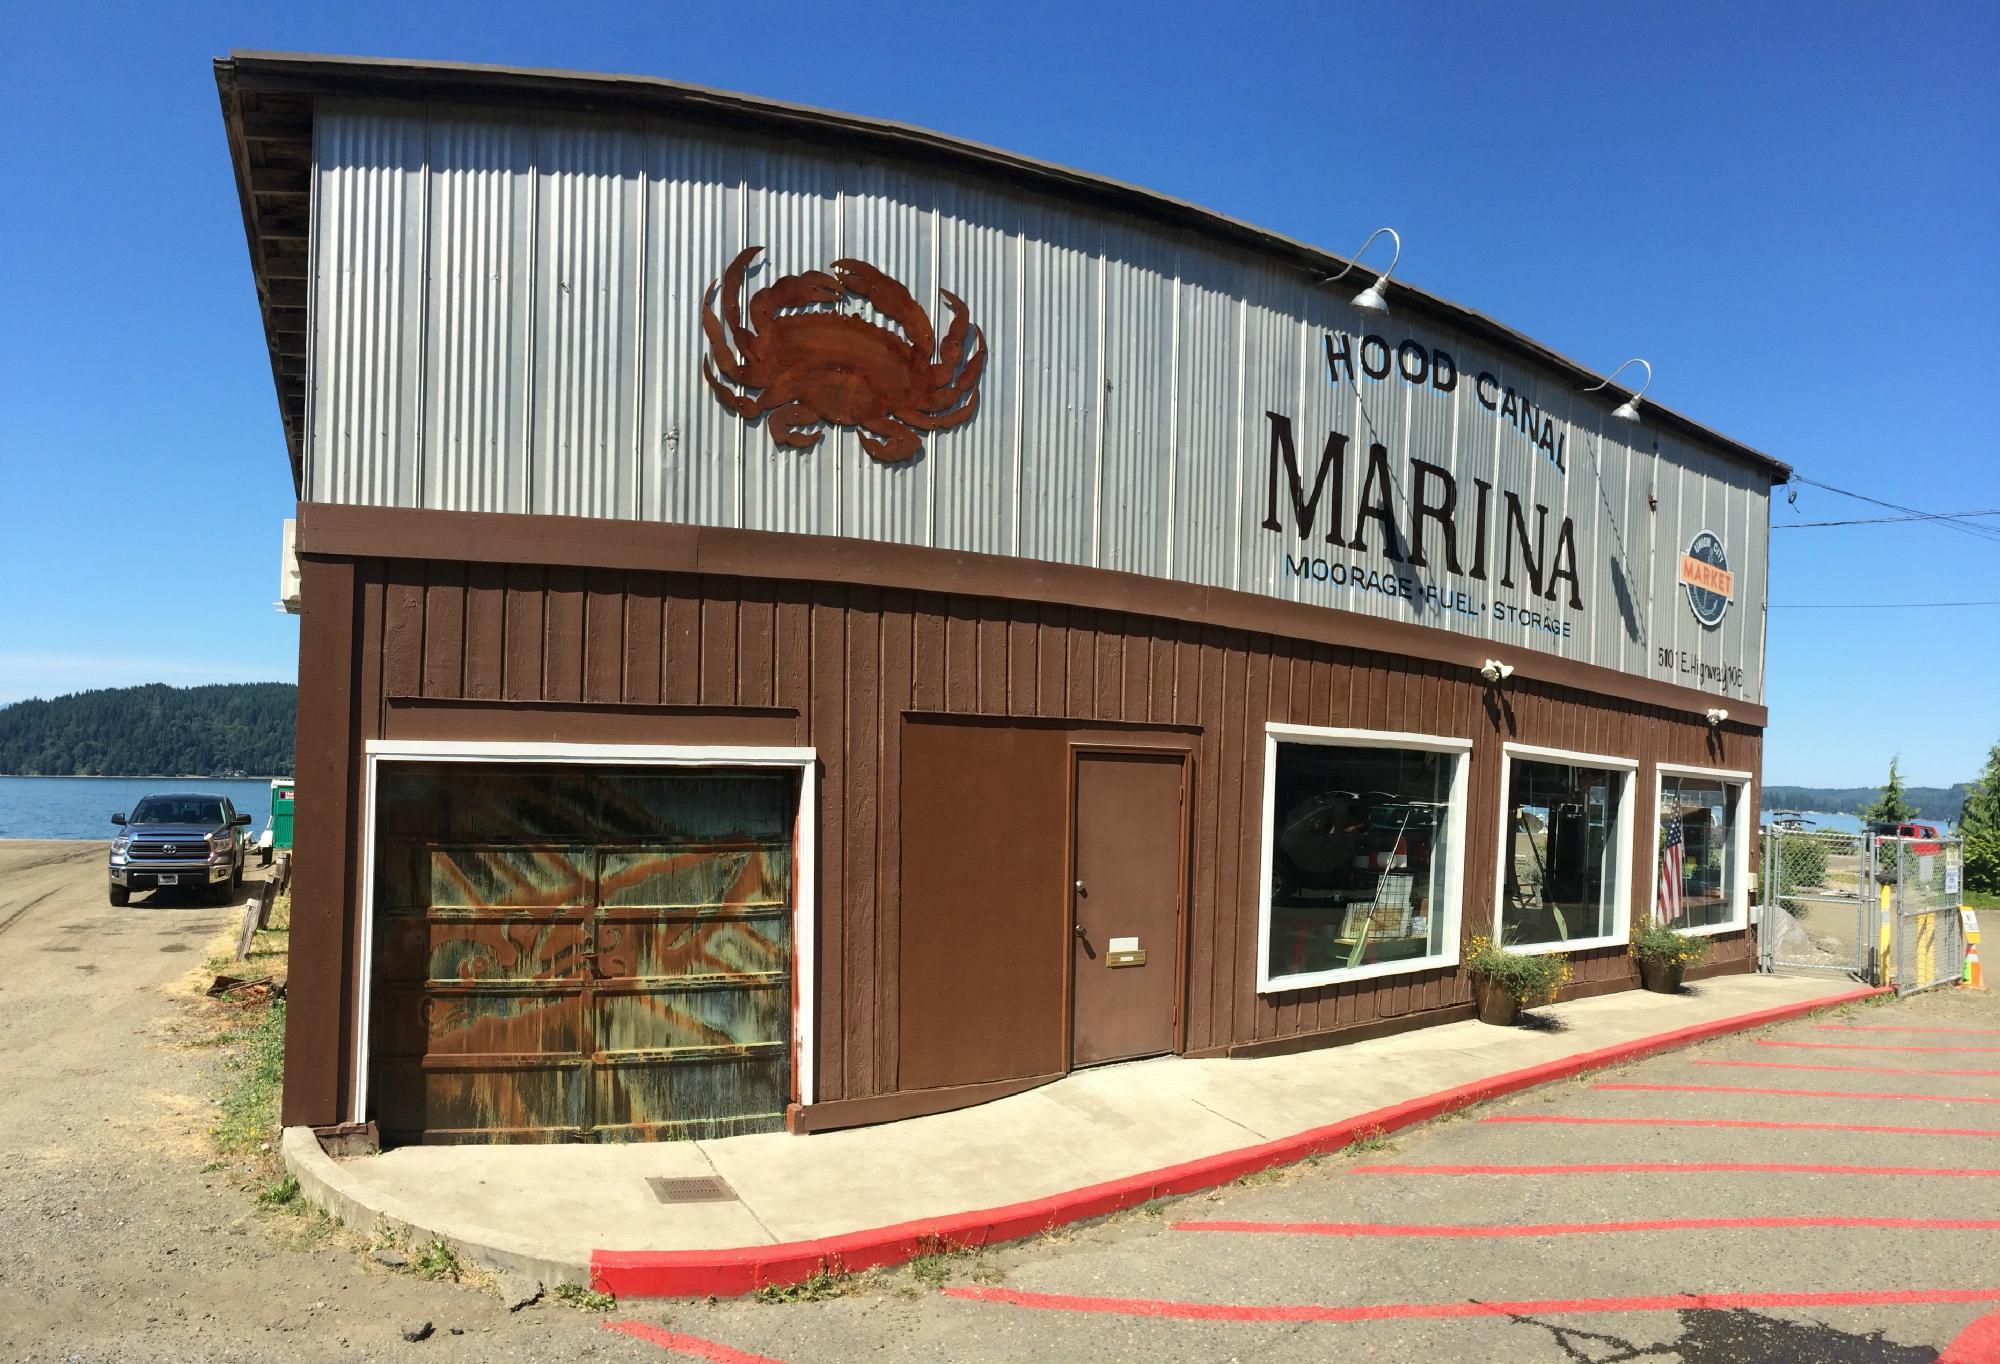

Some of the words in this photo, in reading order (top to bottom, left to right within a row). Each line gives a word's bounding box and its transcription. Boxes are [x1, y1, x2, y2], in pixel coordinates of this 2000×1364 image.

[1325, 334, 1457, 393] HOOD
[1476, 371, 1566, 475] CANAL
[1262, 410, 1584, 611] MARINA
[1285, 553, 1413, 600] MOORAGE
[1426, 585, 1479, 616] FUEL
[1493, 601, 1571, 637] STORAGE
[1683, 559, 1732, 593] MARKET
